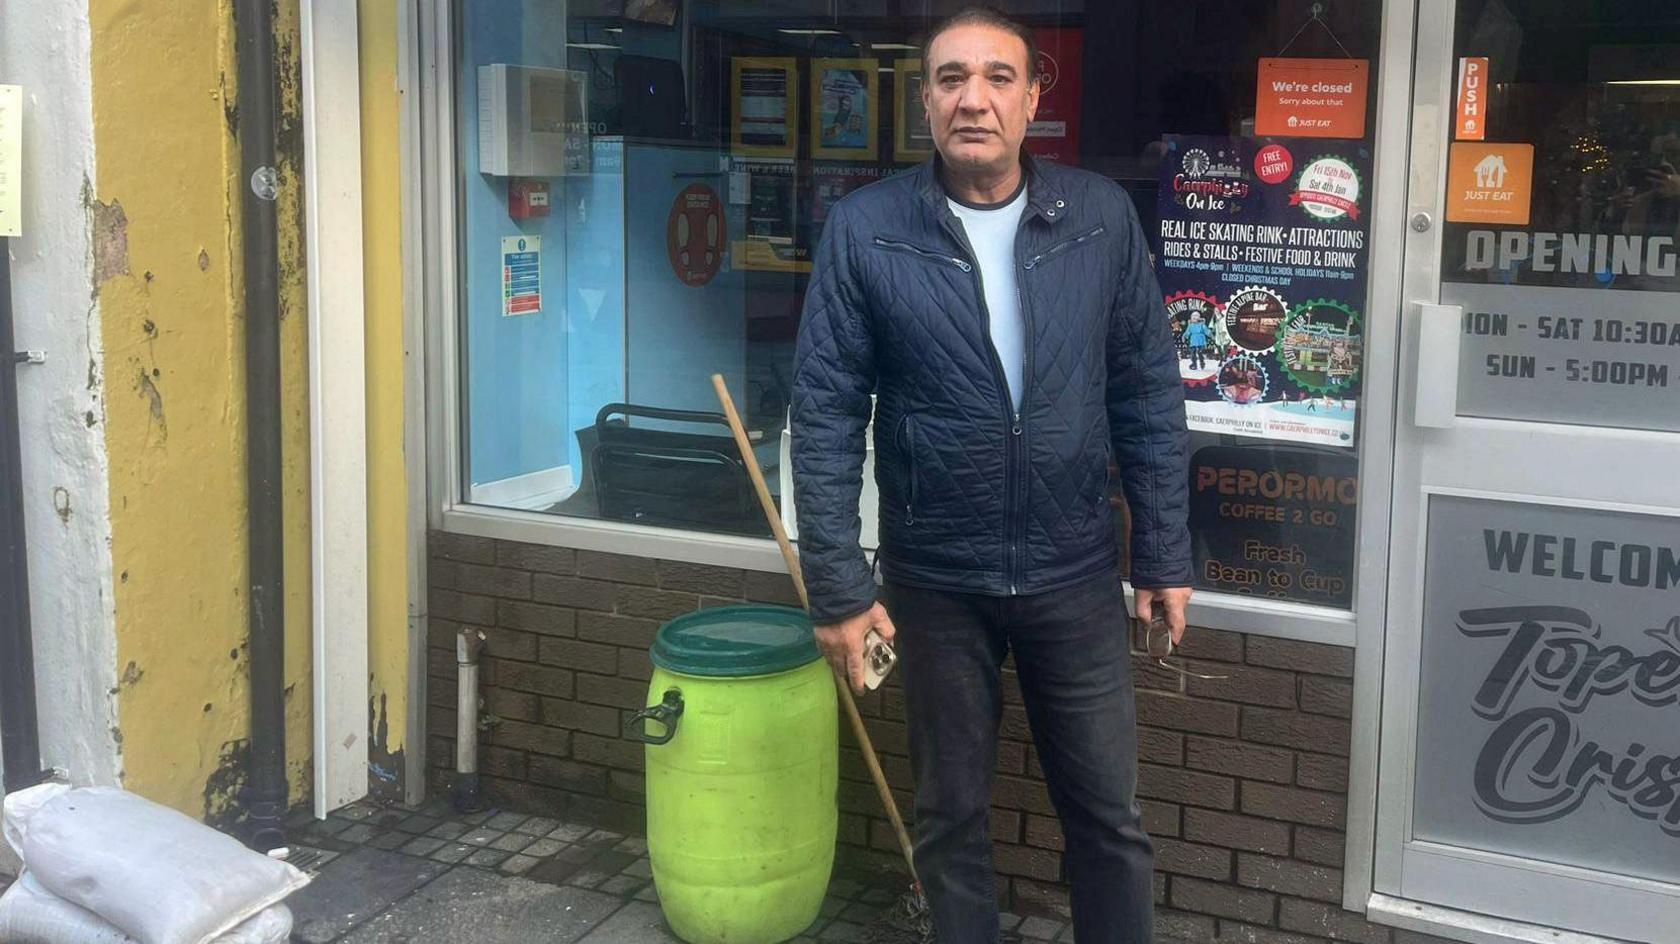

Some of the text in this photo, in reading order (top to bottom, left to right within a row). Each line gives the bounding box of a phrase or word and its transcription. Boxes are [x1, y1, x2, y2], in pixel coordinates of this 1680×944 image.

[1272, 81, 1353, 94] We're closed
[1464, 62, 1480, 116] PUSH
[1279, 97, 1344, 106] Sorry about that
[1298, 120, 1333, 128] JUST EAT
[1263, 151, 1281, 163] FREE
[1261, 162, 1288, 176] ENTRY!
[1313, 164, 1352, 181] Fri 15th Nov
[1309, 179, 1347, 195] Sat 4th Jan
[1464, 190, 1514, 202] JUST EAT
[1186, 192, 1226, 211] On Ice
[1161, 219, 1364, 249] REAL ICE SKATING RINK ATTRACTIONS
[1164, 241, 1356, 269] RIDES & STALLS FESTIVE FOOD & DRINK
[1465, 230, 1677, 277] OPENING
[1164, 259, 1195, 270] WEEKDAYS
[1231, 264, 1265, 275] WEEKENDS
[1265, 265, 1270, 275] &
[1271, 266, 1294, 277] SCHOOL
[1295, 267, 1325, 279] HOLIDAYS
[1221, 272, 1292, 286] CLOSED CHRISTMAS DAY
[1167, 299, 1187, 318] ATING
[1235, 291, 1255, 308] ALPINE
[1254, 292, 1268, 303] BAR
[1538, 317, 1583, 341] SAT
[1486, 354, 1536, 379] SUN
[1566, 359, 1668, 388] 5:00PM
[1219, 502, 1337, 527] COFFEE 2 GO
[1244, 539, 1307, 565] Fresh
[1204, 559, 1262, 586] Bean
[1266, 568, 1292, 588] to
[1298, 568, 1345, 597] Cup
